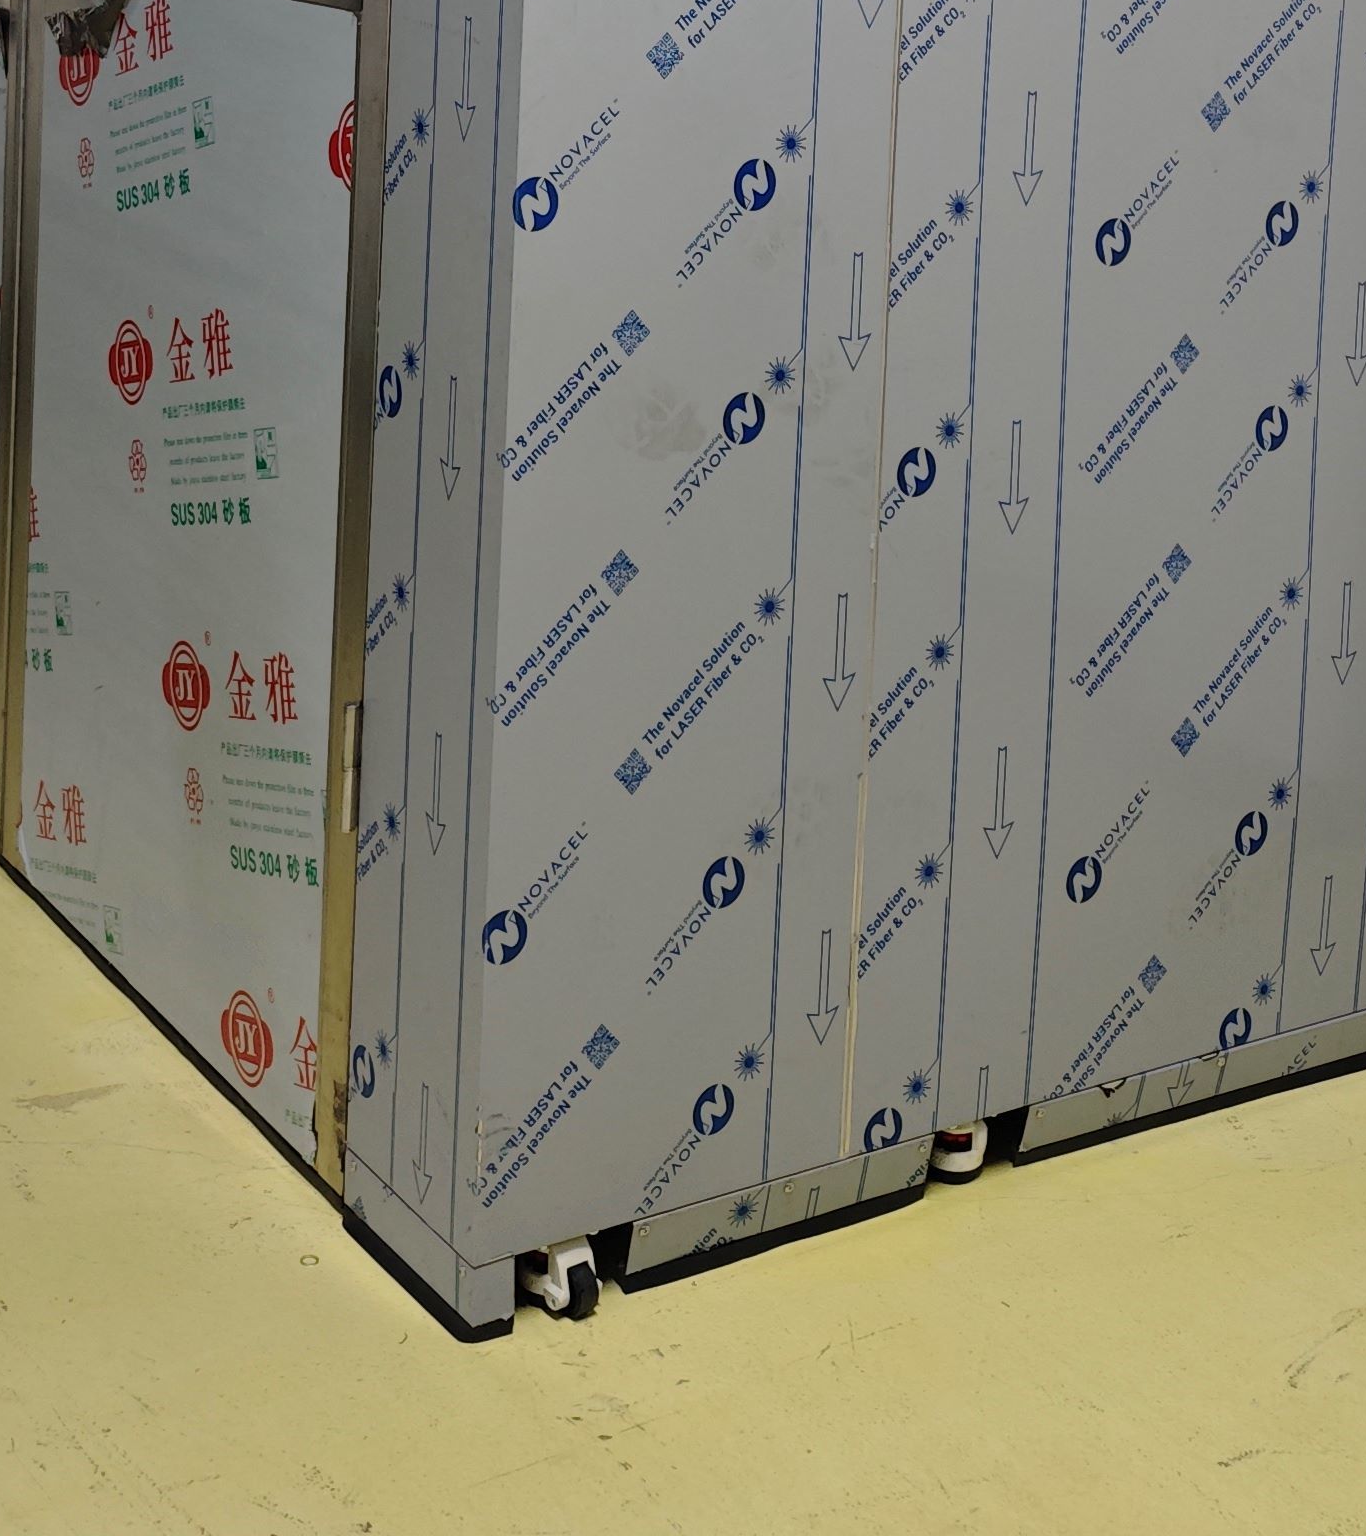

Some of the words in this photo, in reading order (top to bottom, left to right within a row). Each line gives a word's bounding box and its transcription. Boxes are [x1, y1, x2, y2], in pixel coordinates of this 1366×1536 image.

[675, 9, 698, 31] The
[687, 28, 705, 48] for
[1223, 70, 1242, 90] The
[1240, 28, 1274, 72] Novacel
[1233, 87, 1248, 105] for
[1246, 53, 1276, 90] LASER
[1273, 28, 1296, 56] Fiber
[1295, 19, 1304, 31] &
[549, 107, 620, 182] NOVACEL
[117, 186, 139, 212] SUS
[141, 179, 160, 206] 304
[1123, 157, 1179, 223] NOVACEL
[676, 208, 743, 280] NOVACEL
[1219, 243, 1272, 307] NOVACEL
[166, 308, 234, 384] 金雅
[170, 502, 196, 527] SUS
[198, 501, 217, 525] 304
[222, 497, 252, 526] 砂板
[665, 443, 732, 517] NOVACEL
[1211, 448, 1263, 515] NOVACEL
[225, 650, 299, 725] 金雅
[642, 721, 665, 744] The
[662, 669, 705, 722] Novacel
[702, 621, 745, 672] Solution
[655, 738, 673, 760] for
[670, 696, 707, 740] LASER
[704, 664, 732, 698] Fiber
[730, 654, 742, 666] &
[34, 780, 88, 846] 金雅
[1094, 788, 1150, 858] NOVACEL
[230, 844, 256, 873] SUS
[259, 850, 282, 878] 304
[287, 853, 320, 888] 砂板
[517, 831, 588, 912] NOVACEL
[1188, 854, 1241, 923] NOVACEL
[645, 907, 711, 986] NOVACEL
[634, 1134, 701, 1215] NOVACEL
